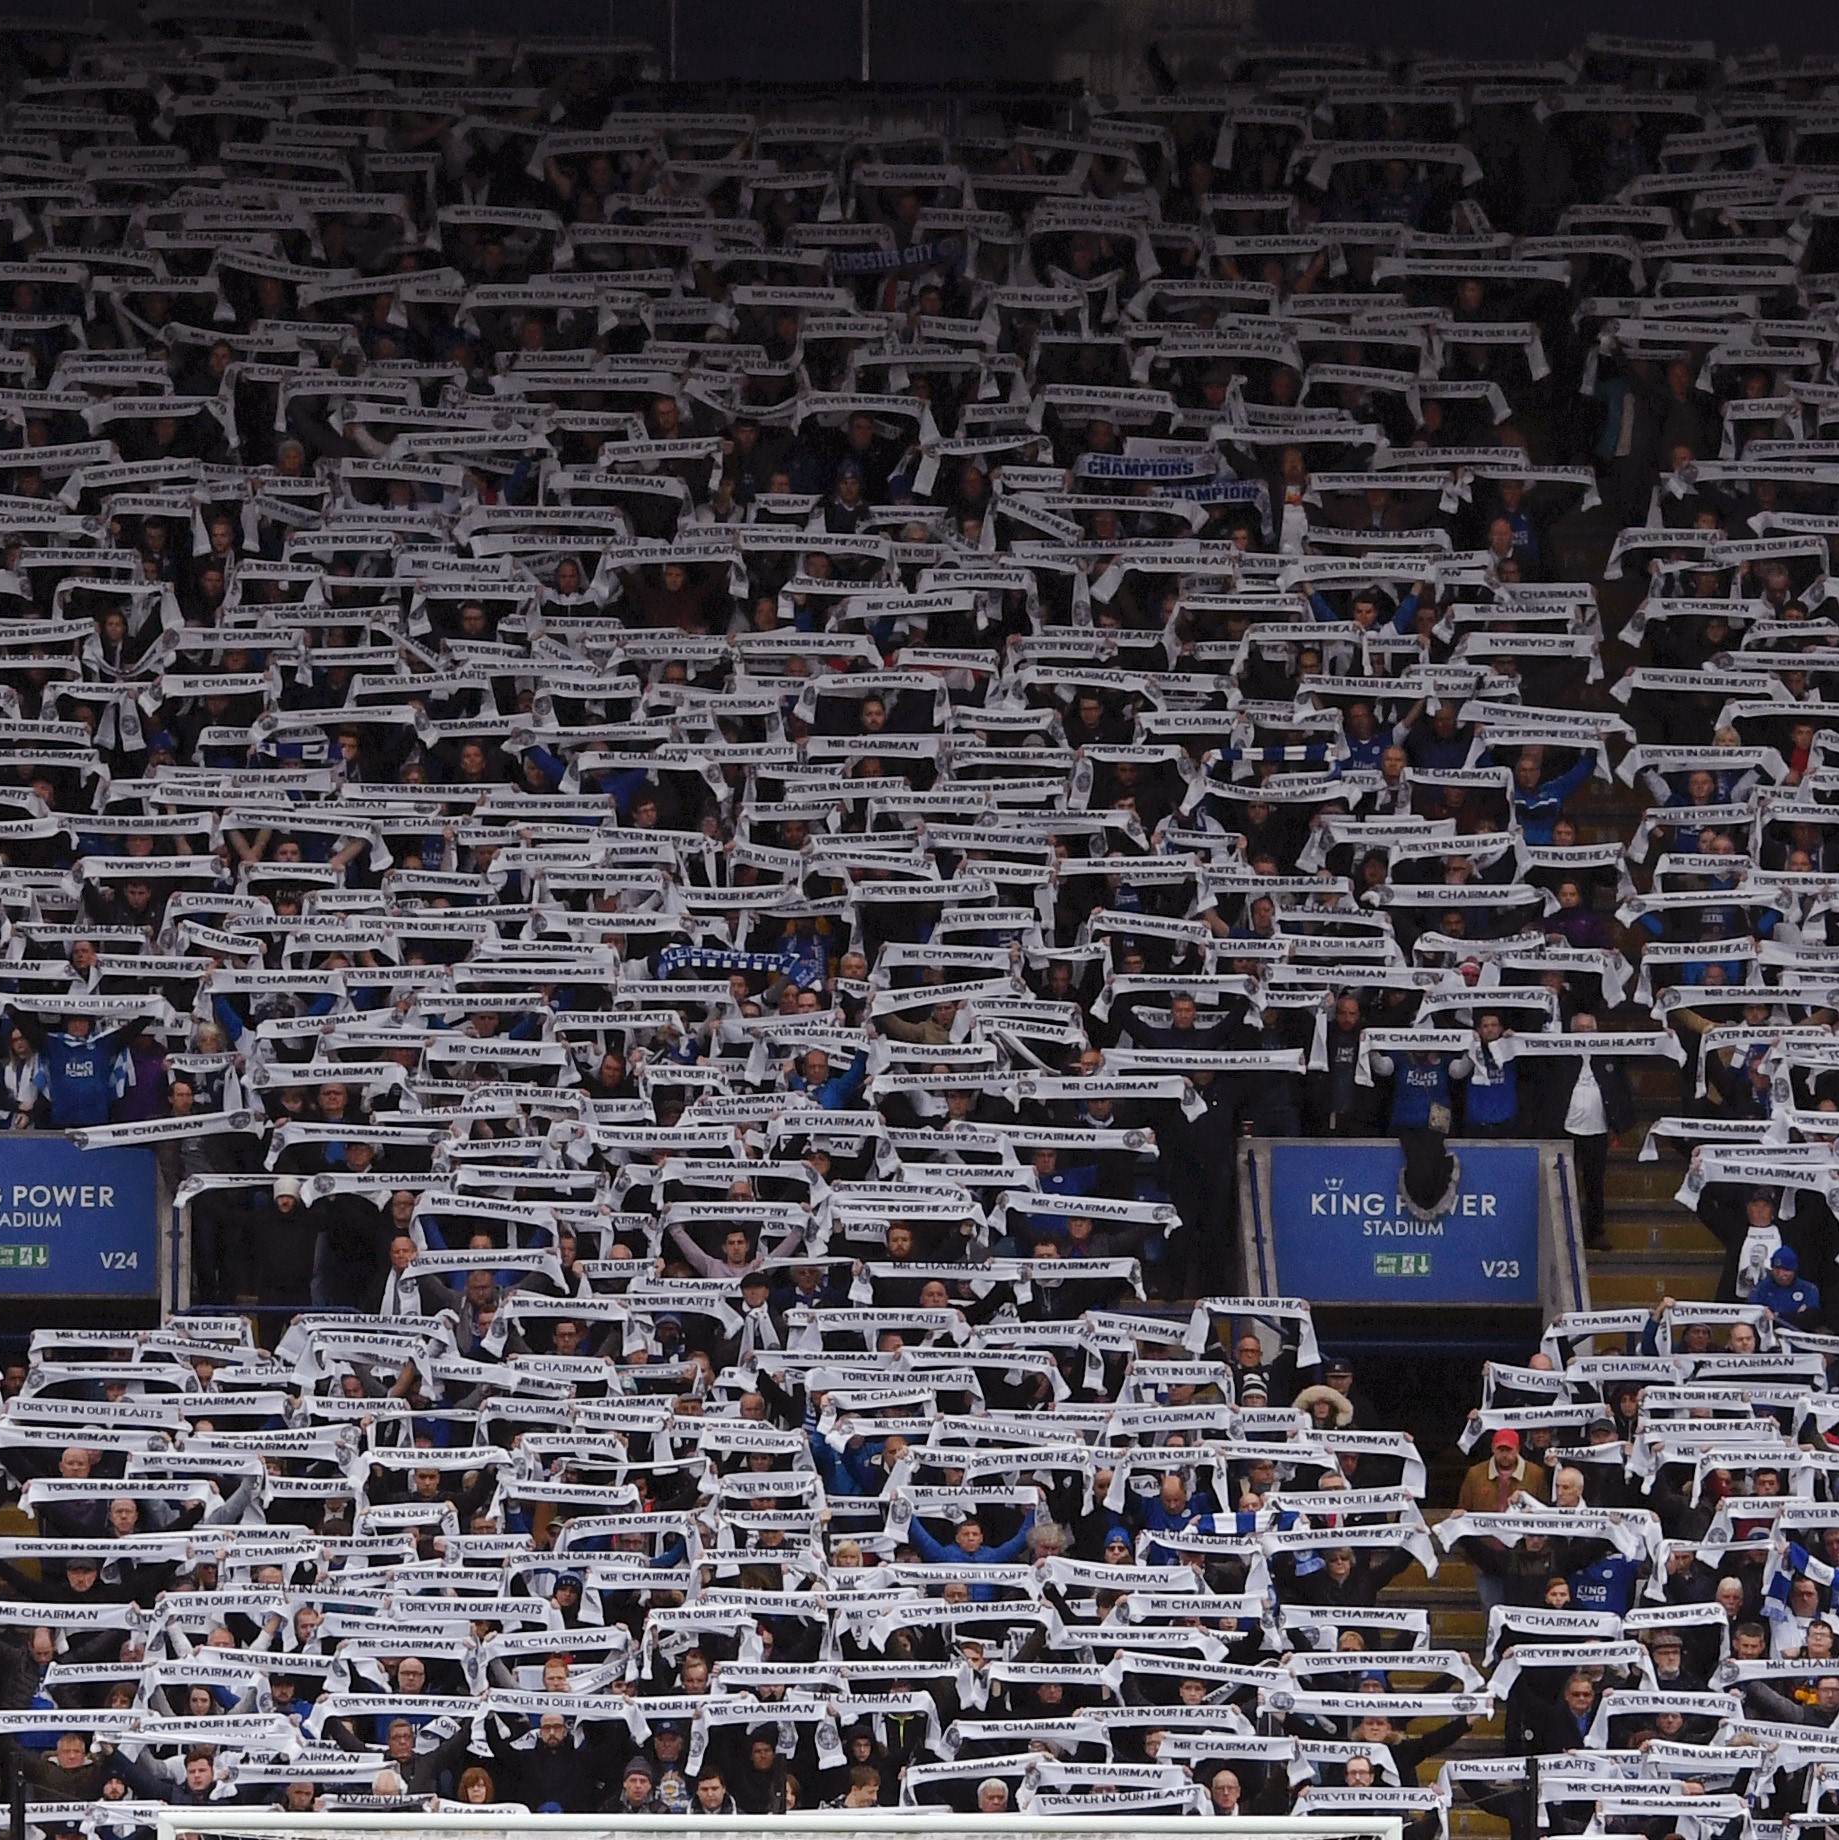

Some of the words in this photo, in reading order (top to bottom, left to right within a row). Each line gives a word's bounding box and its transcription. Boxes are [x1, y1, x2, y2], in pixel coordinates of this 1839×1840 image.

[1087, 462, 1193, 476] CHAMPIONS
[933, 572, 951, 582] MR
[954, 572, 1023, 584] CHAIRMAN
[111, 1127, 128, 1138] MR
[132, 1121, 203, 1136] CHAIRMAN
[478, 1170, 495, 1179] MR
[500, 1170, 569, 1179] CHAIRMAN
[13, 1185, 115, 1208] POWER
[431, 1198, 450, 1207] MR
[455, 1200, 534, 1216] CHAIRMAN
[1312, 1194, 1385, 1216] KING
[1364, 1220, 1444, 1235] STADIUM
[100, 1252, 138, 1269] V24
[1377, 1256, 1396, 1264] Fire
[1377, 1265, 1396, 1274] exit
[1482, 1261, 1520, 1278] V23
[400, 1603, 447, 1613] FOREVER
[451, 1603, 465, 1612] IN
[468, 1603, 491, 1613] OUR
[494, 1603, 543, 1614] HEARTS
[505, 1638, 523, 1648] MR
[527, 1634, 606, 1646] CHAIRMAN
